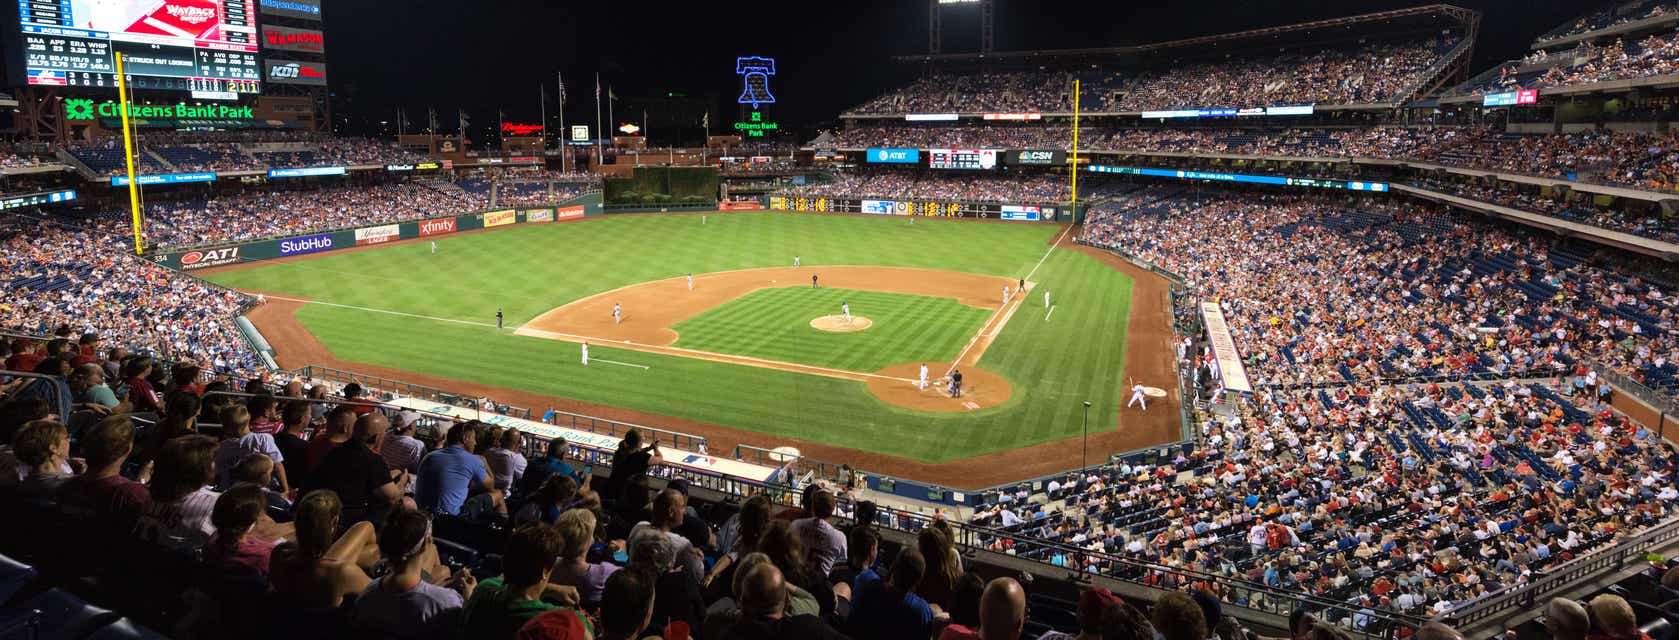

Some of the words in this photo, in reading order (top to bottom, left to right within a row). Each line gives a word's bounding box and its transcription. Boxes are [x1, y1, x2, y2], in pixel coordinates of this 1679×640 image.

[229, 83, 236, 91] 2
[251, 84, 257, 92] 1
[99, 103, 172, 117] Ciizens
[176, 104, 216, 118] Bank
[220, 106, 253, 118] Park
[889, 152, 907, 160] AT&T
[1032, 152, 1052, 160] CSN
[422, 220, 454, 234] xfinity
[281, 238, 331, 253] StubHub
[202, 248, 238, 261] ATI
[182, 262, 210, 271] PHYSICAL
[212, 258, 236, 266] THERAPY
[506, 421, 557, 436] Citizens
[560, 431, 594, 444] Bank
[600, 438, 618, 448] Pa
